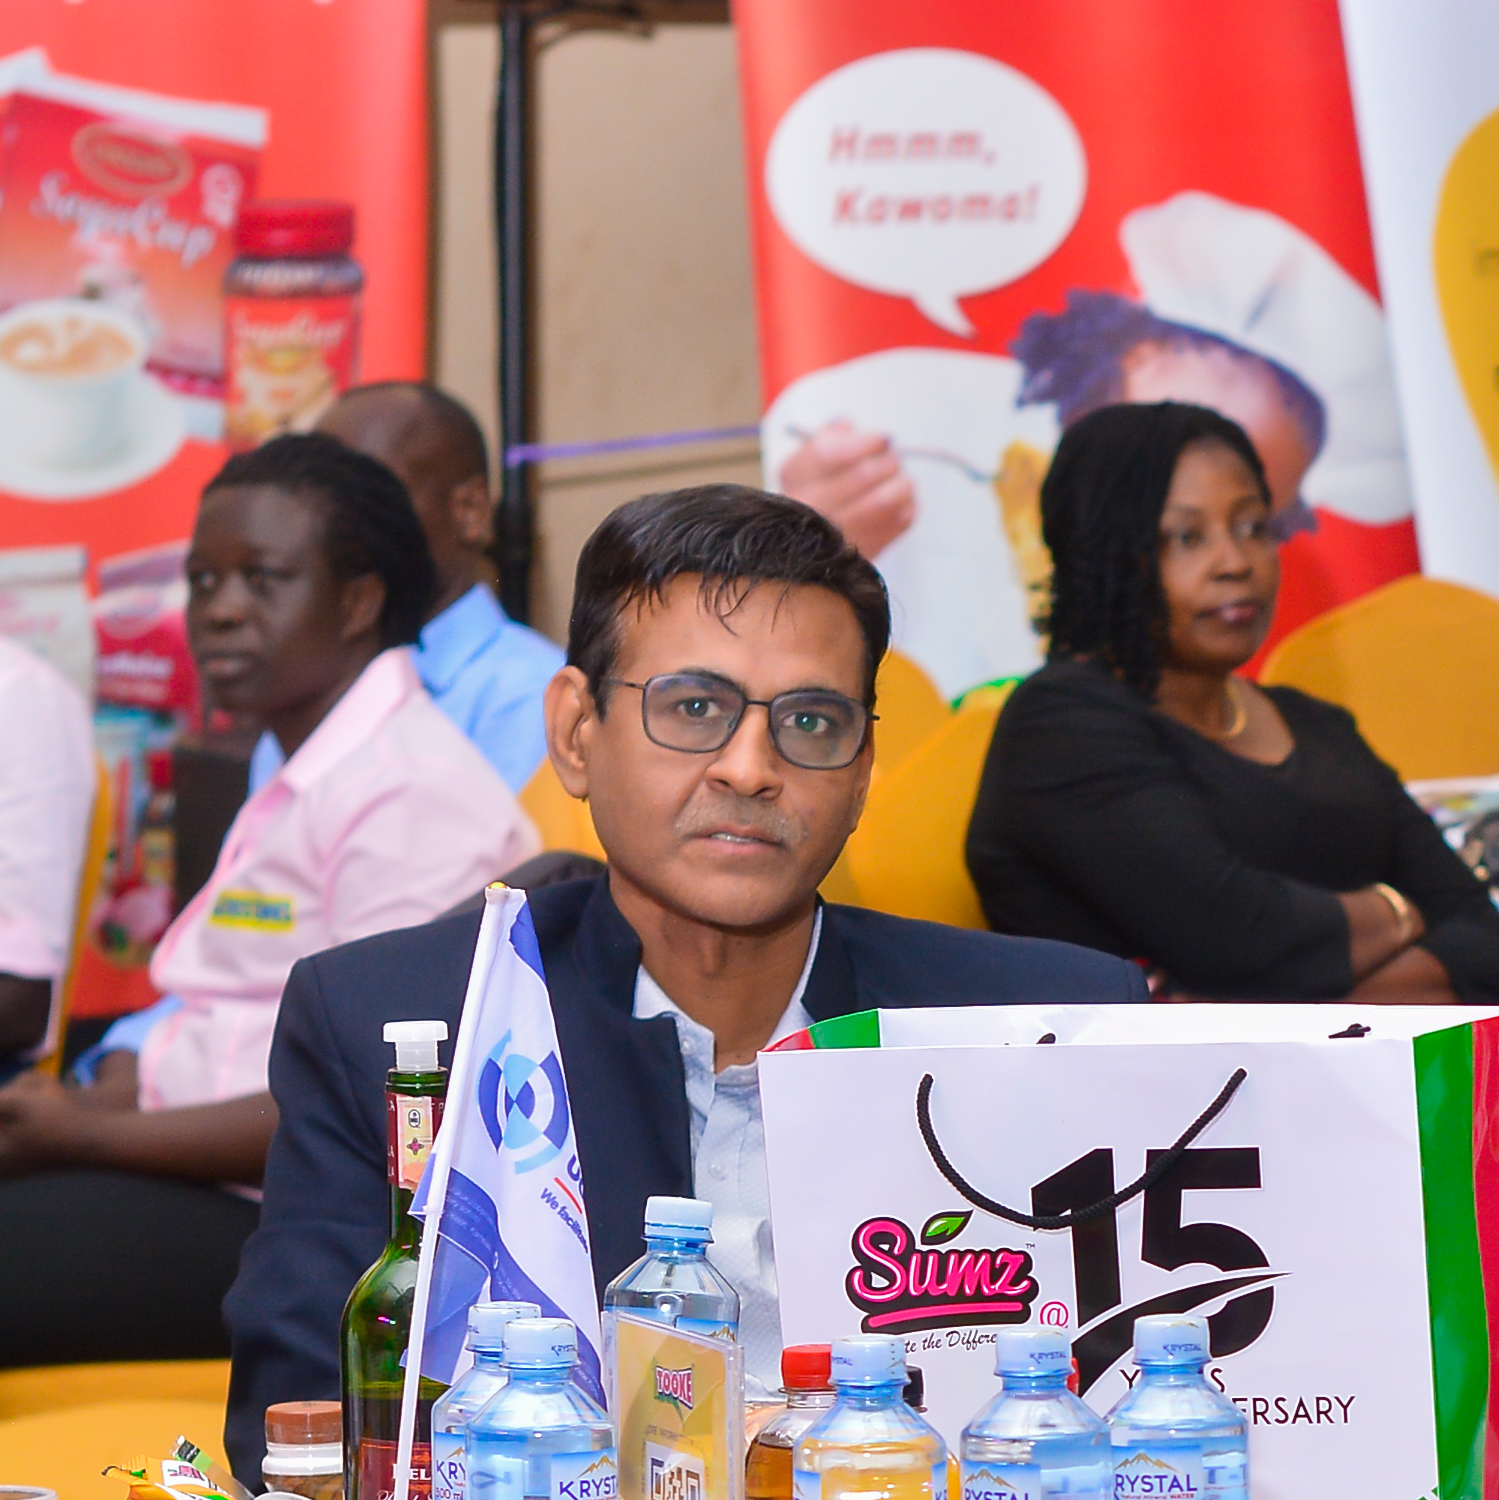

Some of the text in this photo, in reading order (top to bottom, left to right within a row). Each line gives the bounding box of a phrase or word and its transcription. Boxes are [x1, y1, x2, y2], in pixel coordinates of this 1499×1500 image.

[829, 127, 996, 166] Hmmm,
[834, 187, 1041, 226] Kawoma!
[540, 1188, 560, 1210] We
[849, 1217, 1032, 1300] Sumz
[1039, 1299, 1069, 1330] @
[922, 1334, 943, 1352] the
[945, 1330, 999, 1351] Differe
[656, 1370, 693, 1406] TOOKE
[454, 1490, 463, 1500] ml
